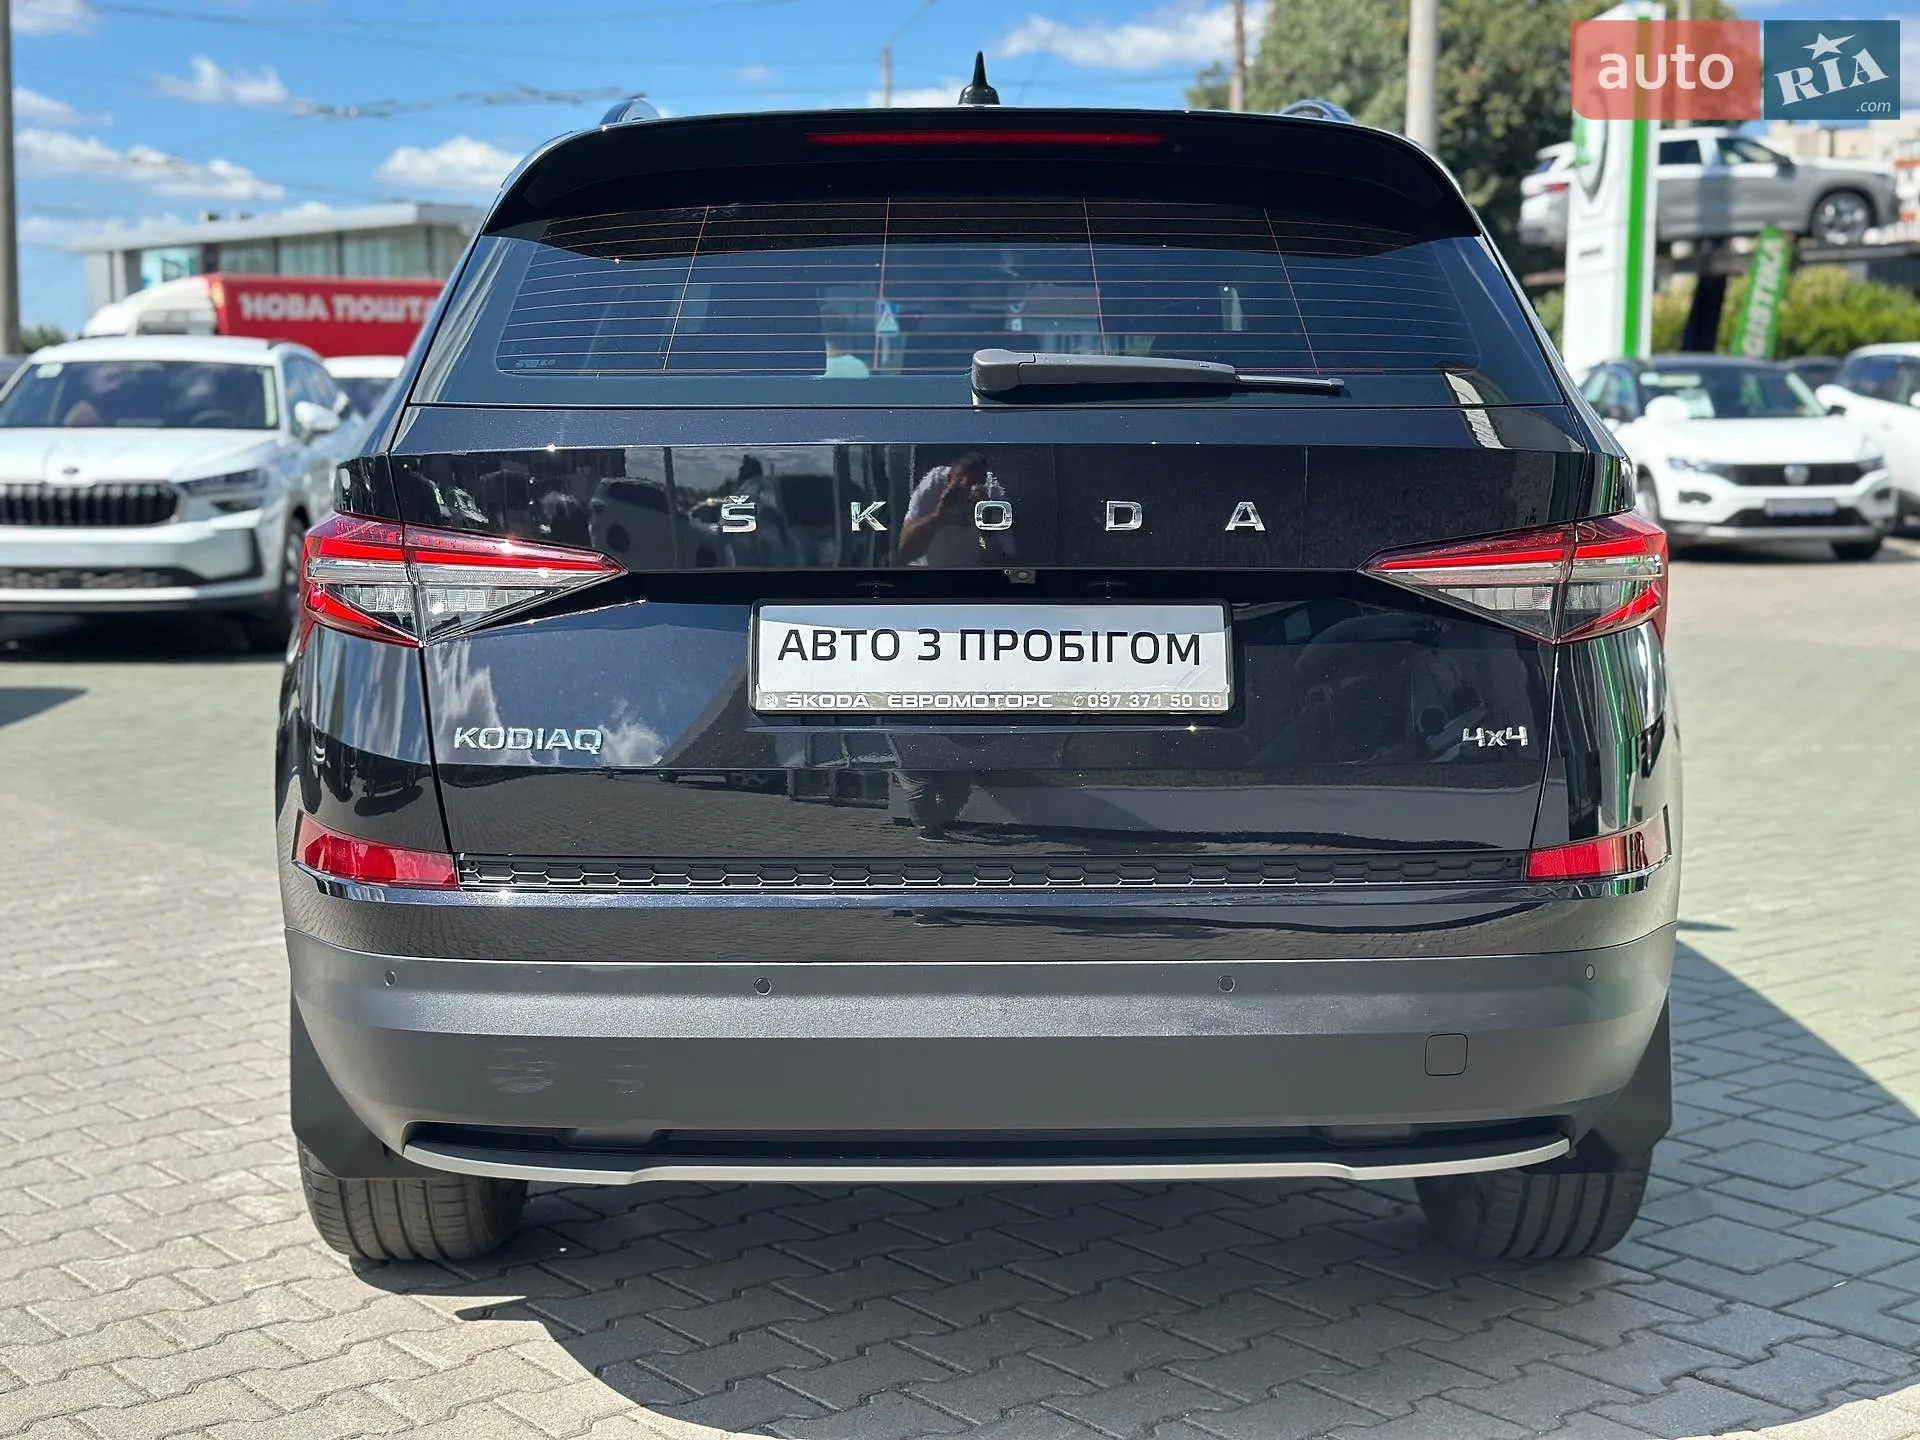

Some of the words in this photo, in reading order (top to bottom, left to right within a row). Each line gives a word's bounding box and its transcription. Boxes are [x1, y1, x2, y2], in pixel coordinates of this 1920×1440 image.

[238, 291, 330, 322] НОВА
[778, 628, 900, 662] АВТО
[960, 629, 1201, 666] ПРОБІГОМ
[1170, 694, 1193, 707] 50
[454, 726, 603, 755] KODIAQ
[1462, 726, 1529, 747] 4x4
